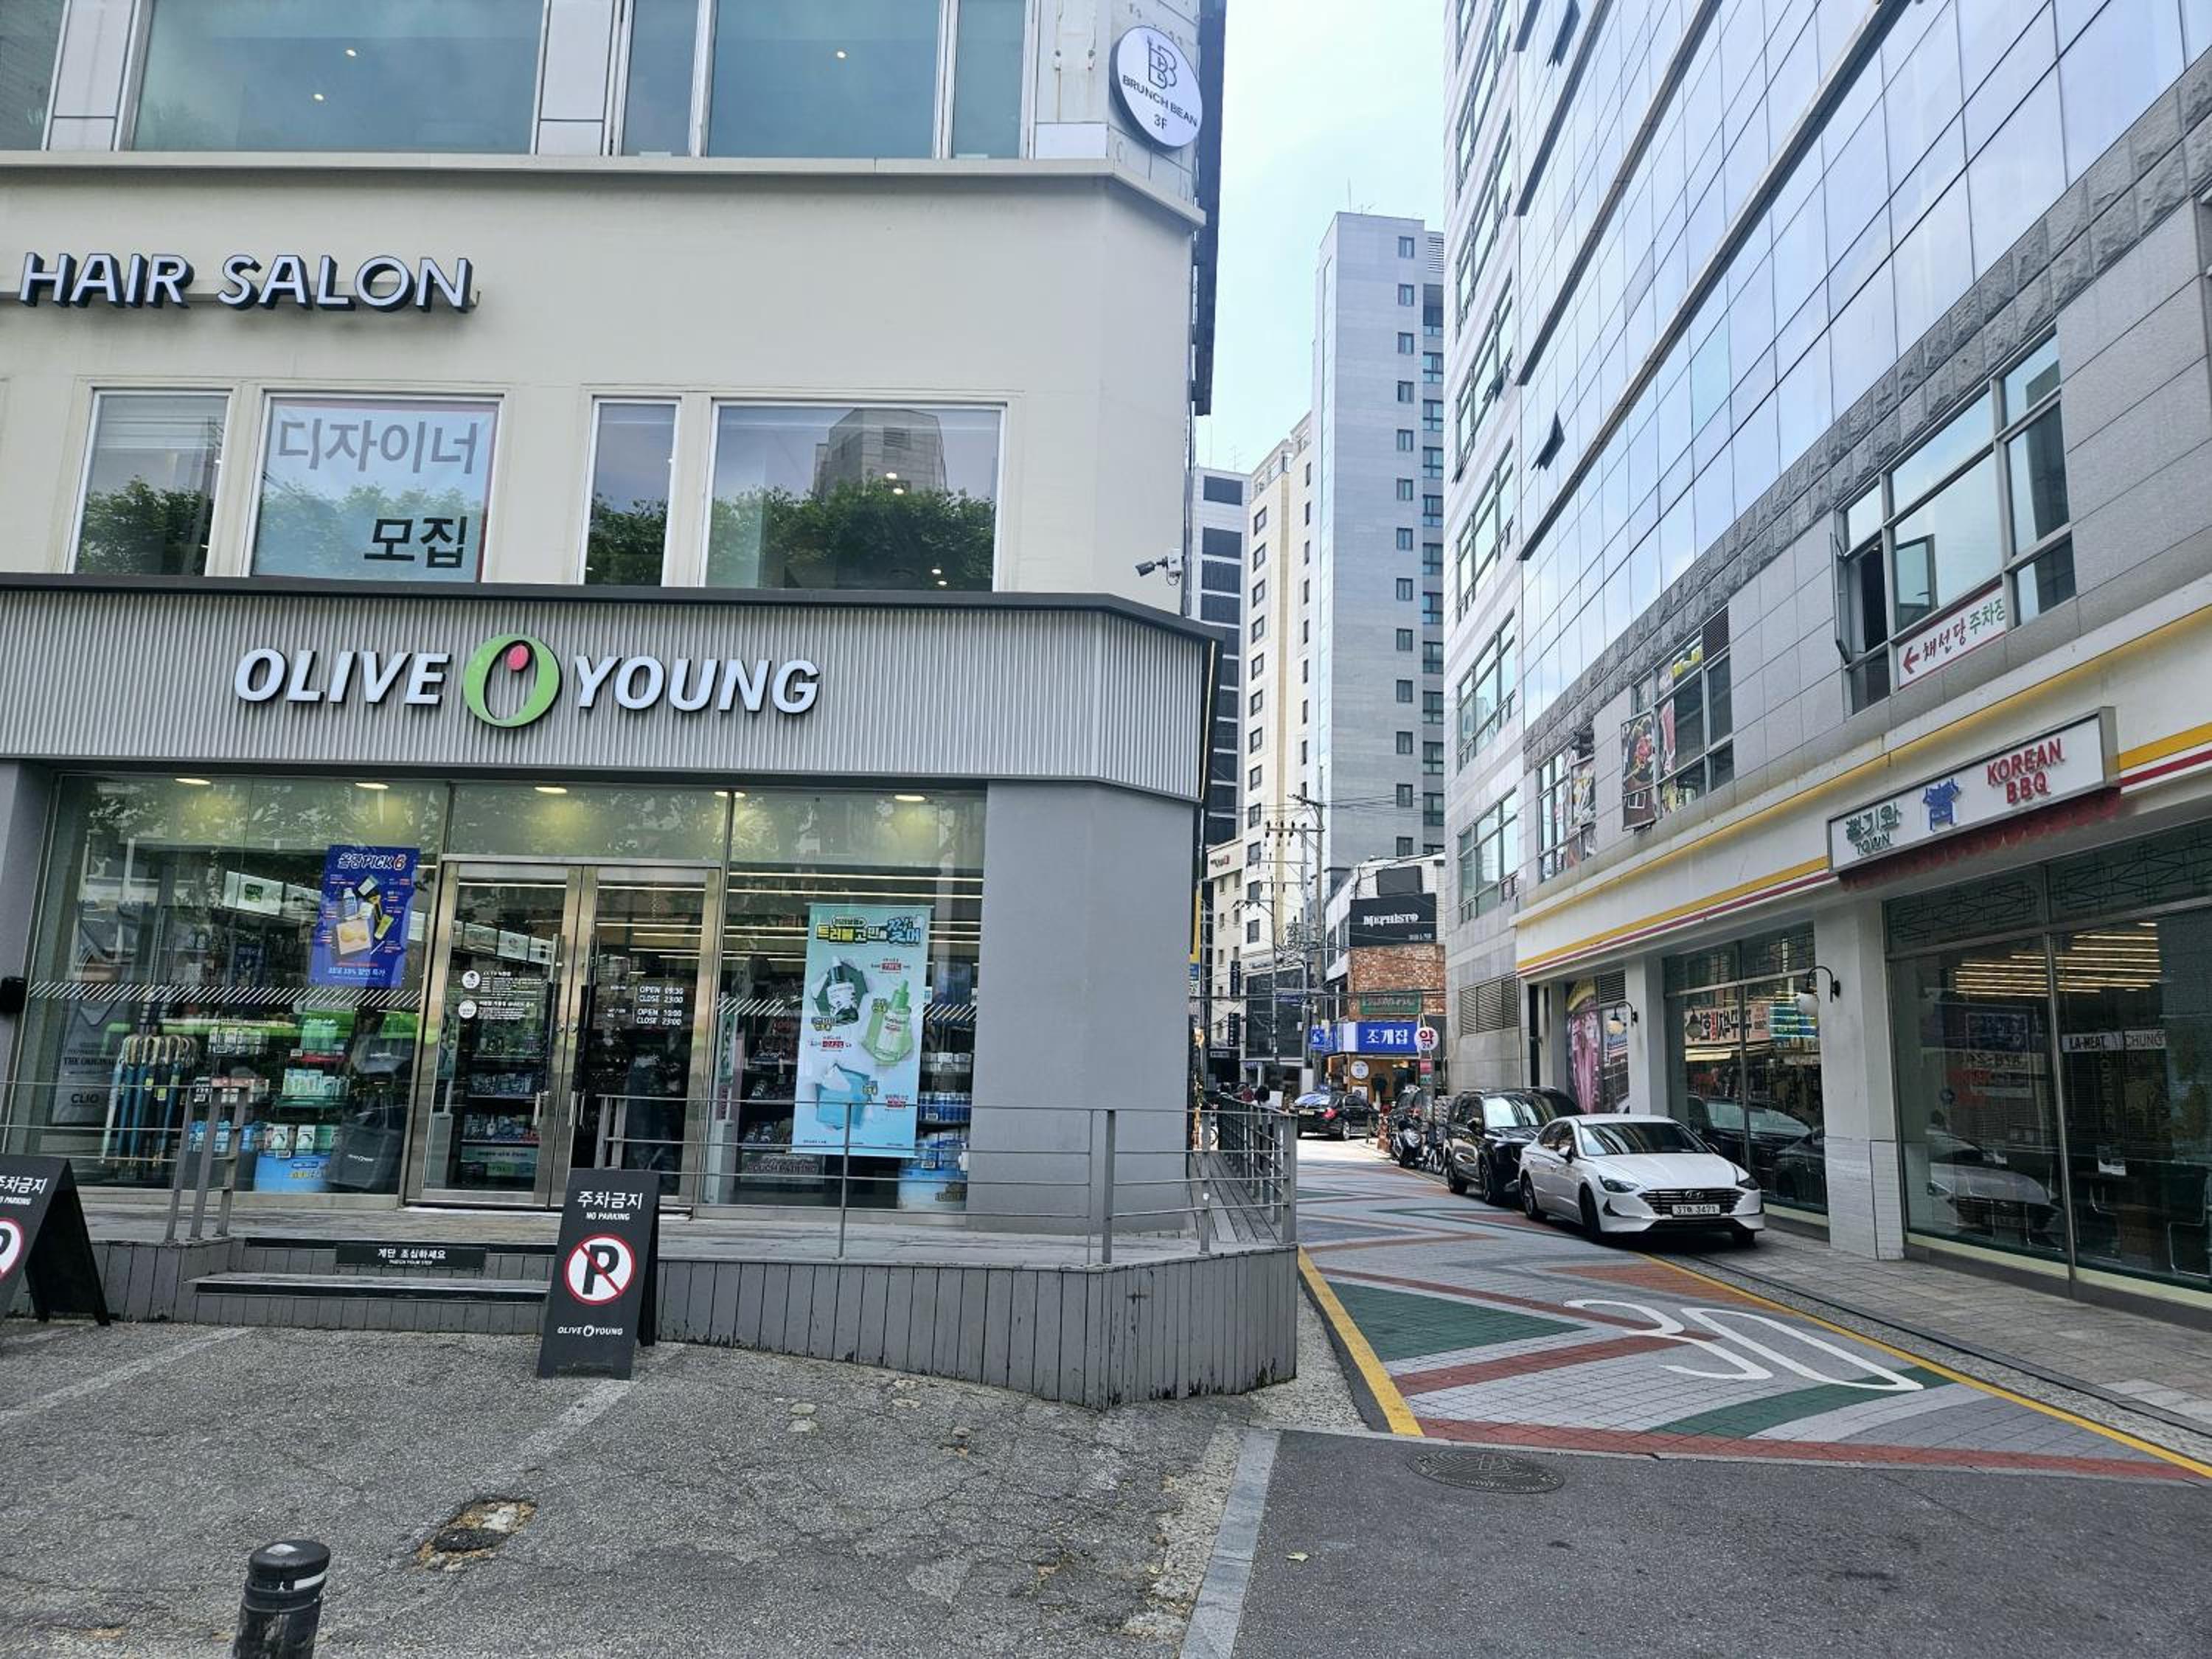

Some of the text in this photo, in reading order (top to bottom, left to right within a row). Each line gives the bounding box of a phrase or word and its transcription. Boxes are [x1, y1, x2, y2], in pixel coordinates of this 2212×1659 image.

[1122, 75, 1197, 127] BRUNCH BEAN
[1154, 114, 1167, 130] 3F
[19, 252, 473, 313] HAIR SALON
[277, 417, 479, 474] 디자이너
[364, 515, 467, 568] 모집
[1922, 616, 1966, 661] 채선당
[233, 647, 821, 714] OLIVE YOUNG
[1986, 737, 2064, 787] KOREAN
[2005, 771, 2051, 805] BBQ
[1855, 831, 1893, 856] TOWN
[637, 1008, 658, 1016] OPEN
[1366, 1029, 1408, 1045] 조개집
[1419, 1030, 1434, 1045] 약
[71, 1093, 99, 1104] CLIO
[4, 1197, 32, 1206] PARKING
[577, 1190, 644, 1209] 주차금지
[585, 1211, 630, 1220] NO PARKING
[378, 1248, 446, 1259] 계단 조심하세요
[557, 1326, 623, 1335] OLIVE YOUNG
[1563, 1298, 1924, 1391] 30
